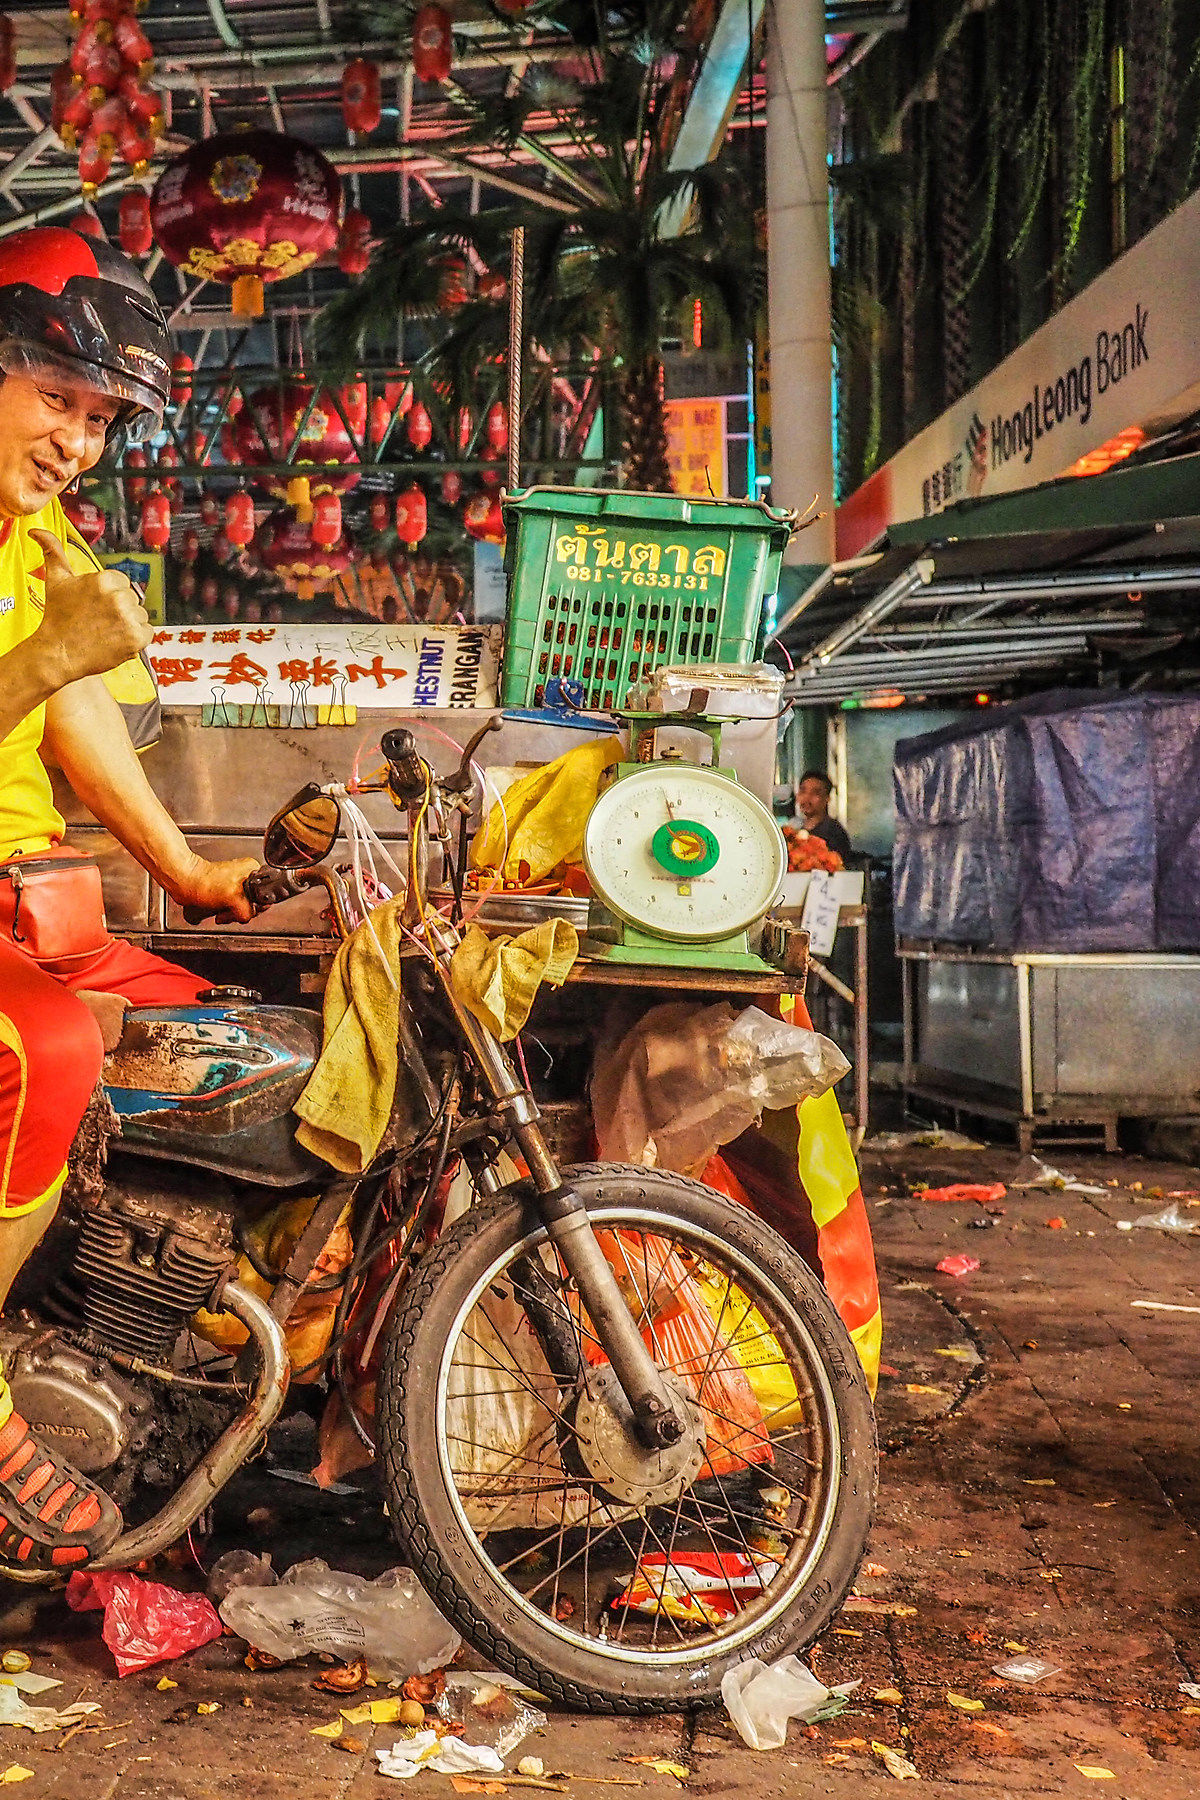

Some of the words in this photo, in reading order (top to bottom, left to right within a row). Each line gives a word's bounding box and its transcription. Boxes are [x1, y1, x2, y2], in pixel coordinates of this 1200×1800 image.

[1095, 303, 1150, 395] Bank
[566, 565, 709, 591] 081-7633131
[149, 652, 408, 690] 糖炒栗子
[412, 637, 446, 706] HESTNUT
[448, 632, 485, 708] ERANGAN
[29, 1421, 91, 1440] ONDA
